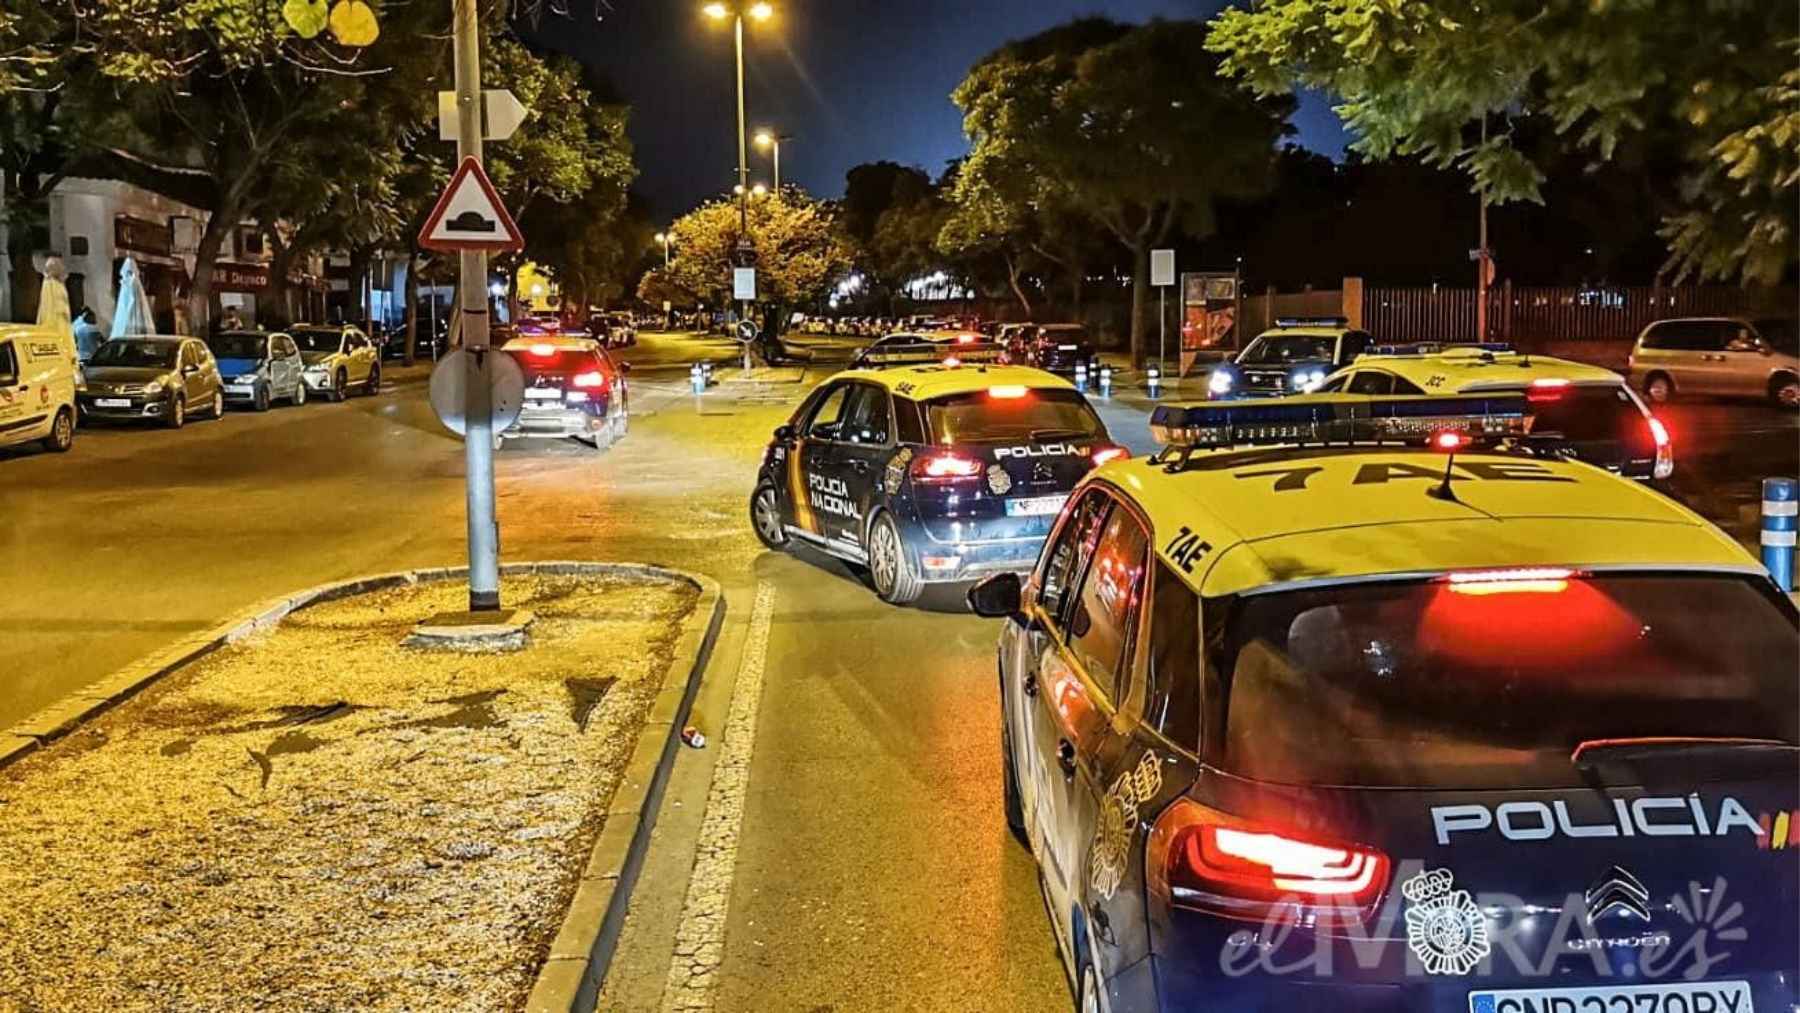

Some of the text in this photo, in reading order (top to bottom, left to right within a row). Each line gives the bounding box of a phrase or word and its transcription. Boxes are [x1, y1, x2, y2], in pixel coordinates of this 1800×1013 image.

[811, 490, 863, 520] NACIONAL
[1165, 526, 1213, 574] 7AE
[1431, 792, 1765, 845] POLICÍA
